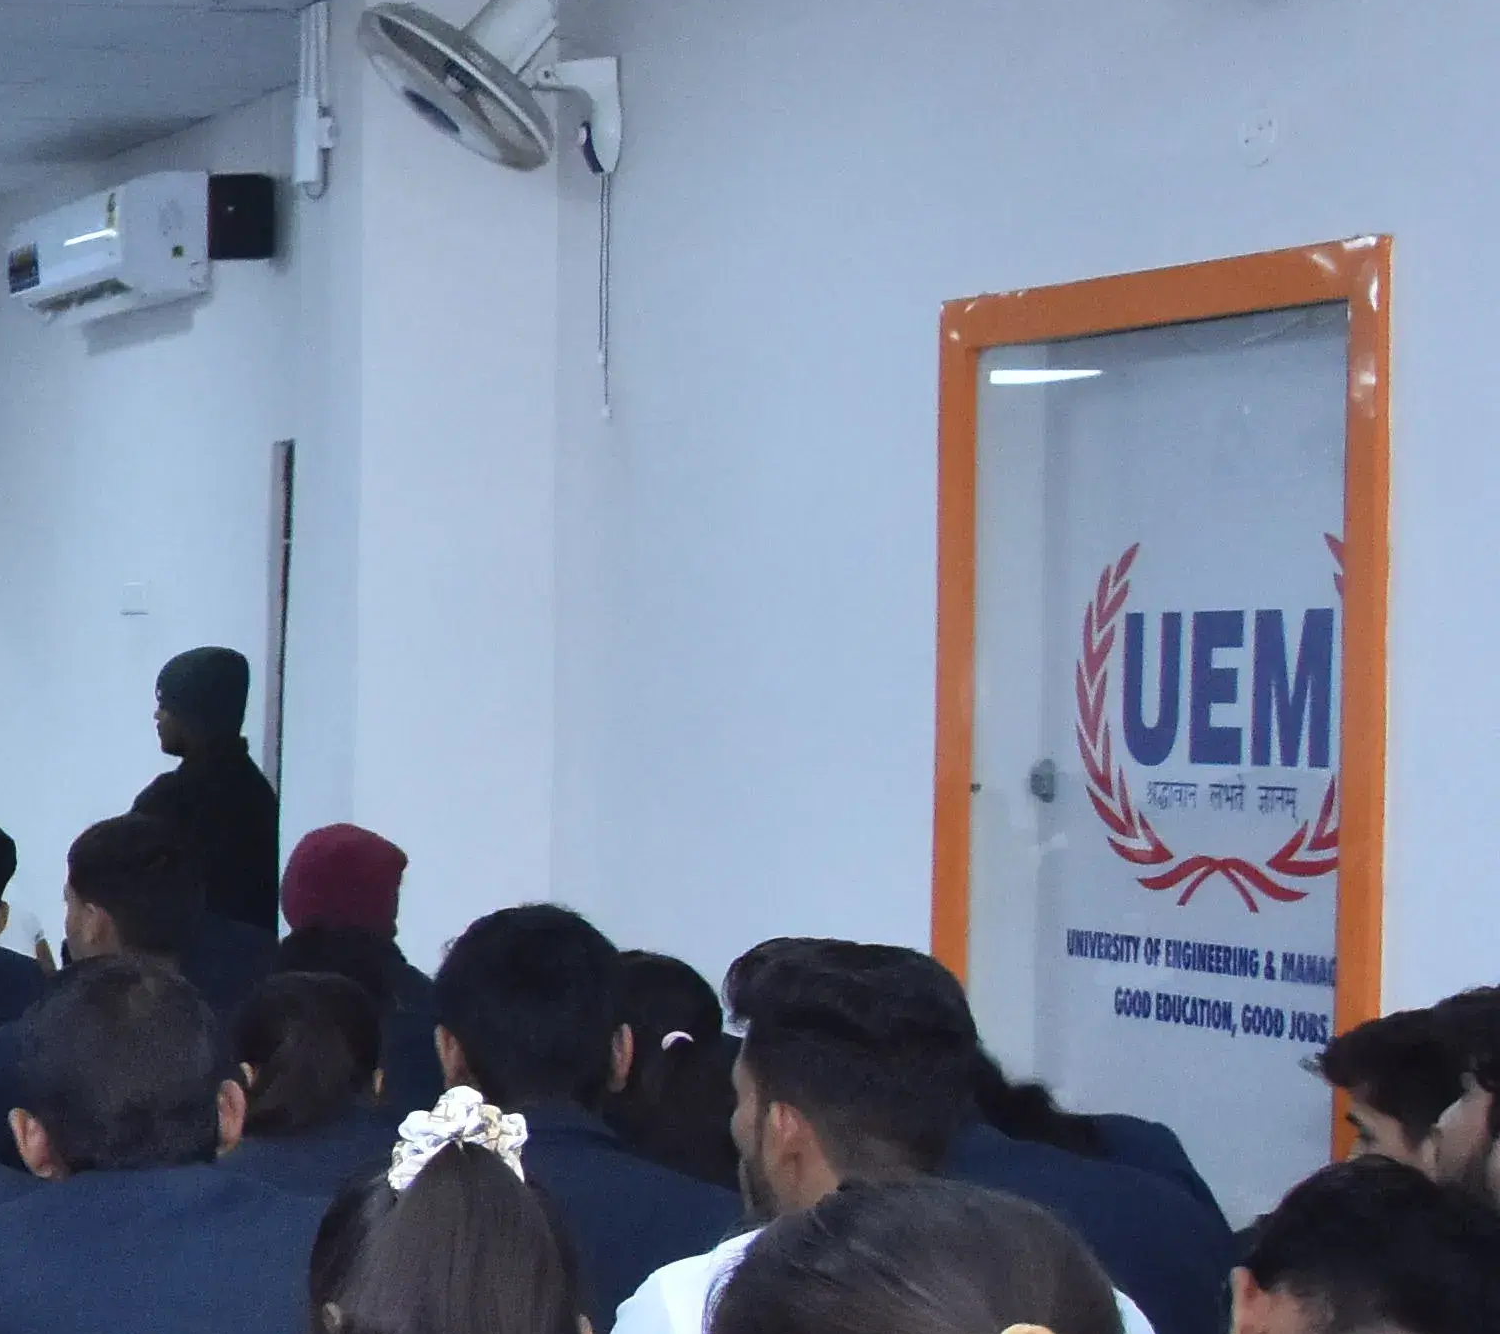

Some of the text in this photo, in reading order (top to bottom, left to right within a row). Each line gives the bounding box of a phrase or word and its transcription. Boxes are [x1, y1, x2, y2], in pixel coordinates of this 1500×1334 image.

[1122, 608, 1334, 768] UEM
[1066, 928, 1337, 988] UNIVERSITY OF ENGINEERING & MANAG
[1114, 986, 1151, 1019] GOOD
[1155, 991, 1238, 1038] EDUCATION,
[1241, 1003, 1285, 1040] GOOD
